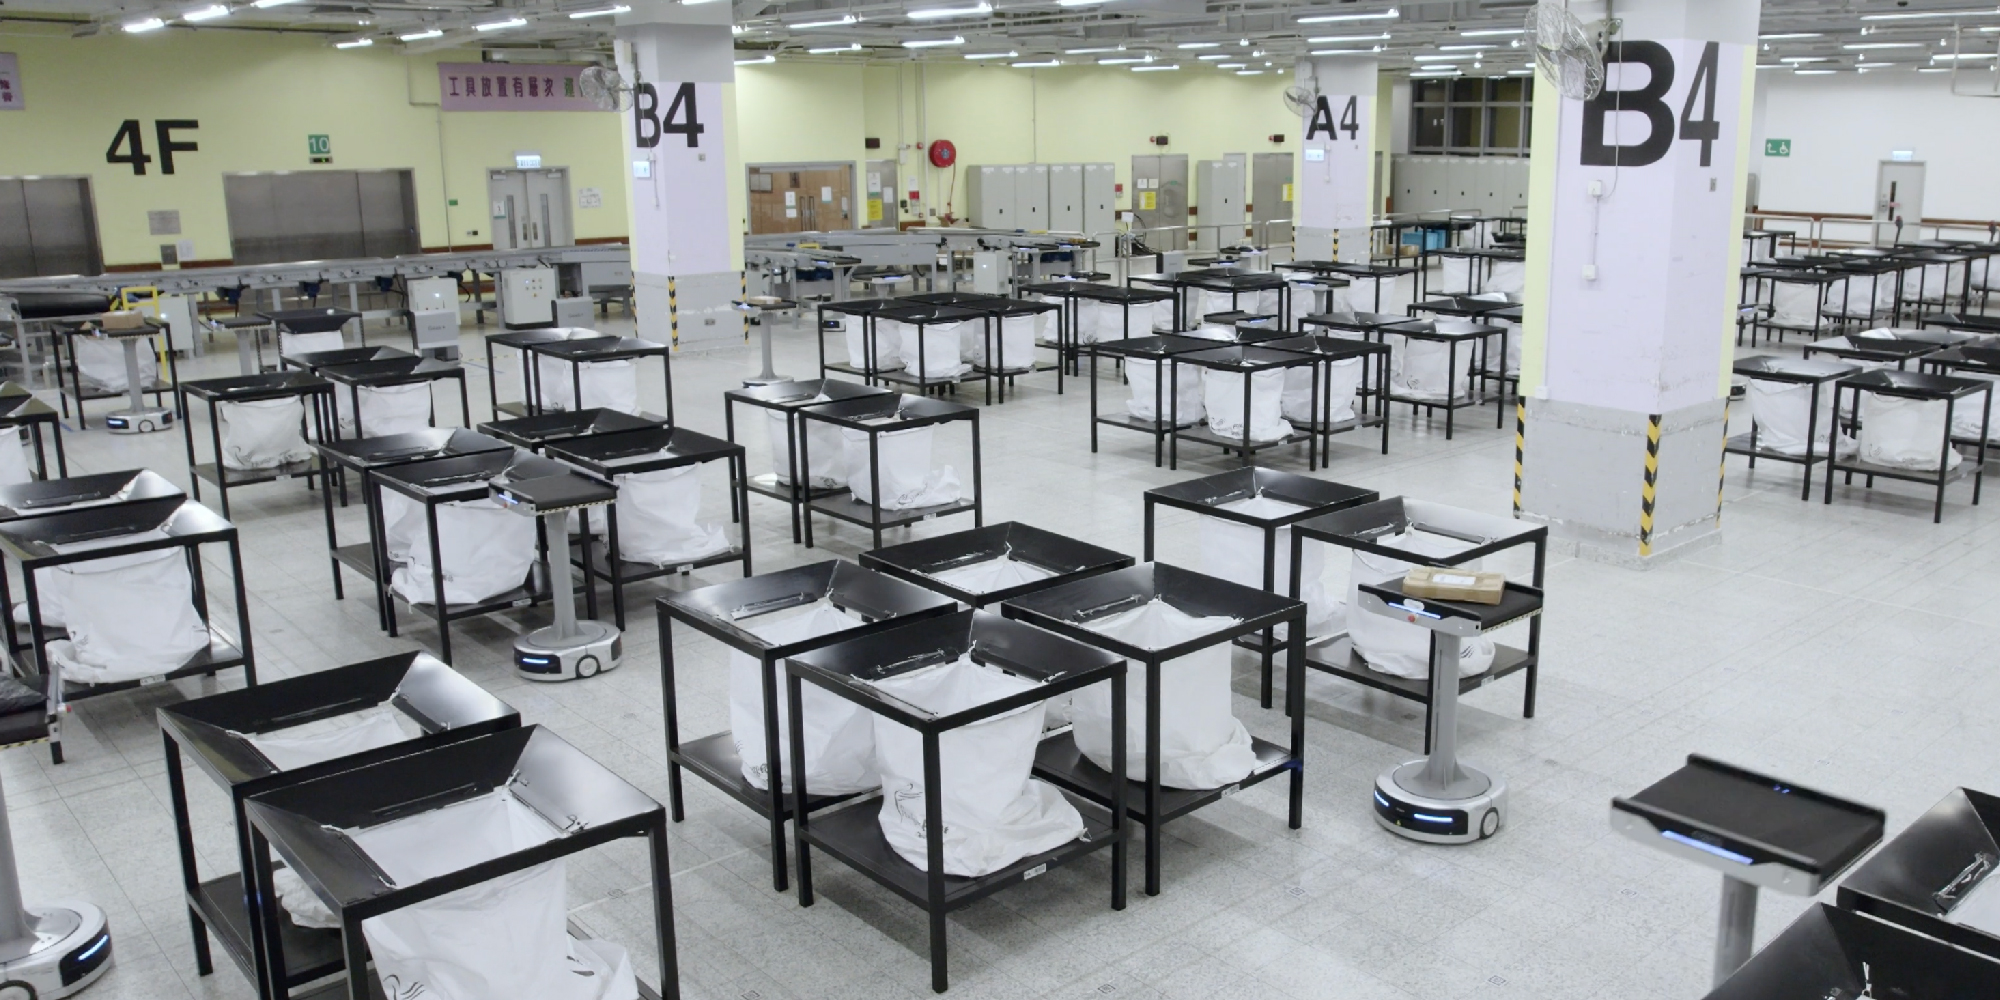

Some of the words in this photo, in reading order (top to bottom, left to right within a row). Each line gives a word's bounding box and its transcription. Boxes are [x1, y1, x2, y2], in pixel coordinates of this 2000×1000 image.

[633, 82, 704, 148] B4
[1306, 95, 1359, 140] A4
[1580, 40, 1720, 166] B4
[106, 119, 199, 175] 4F
[310, 137, 329, 152] 10
